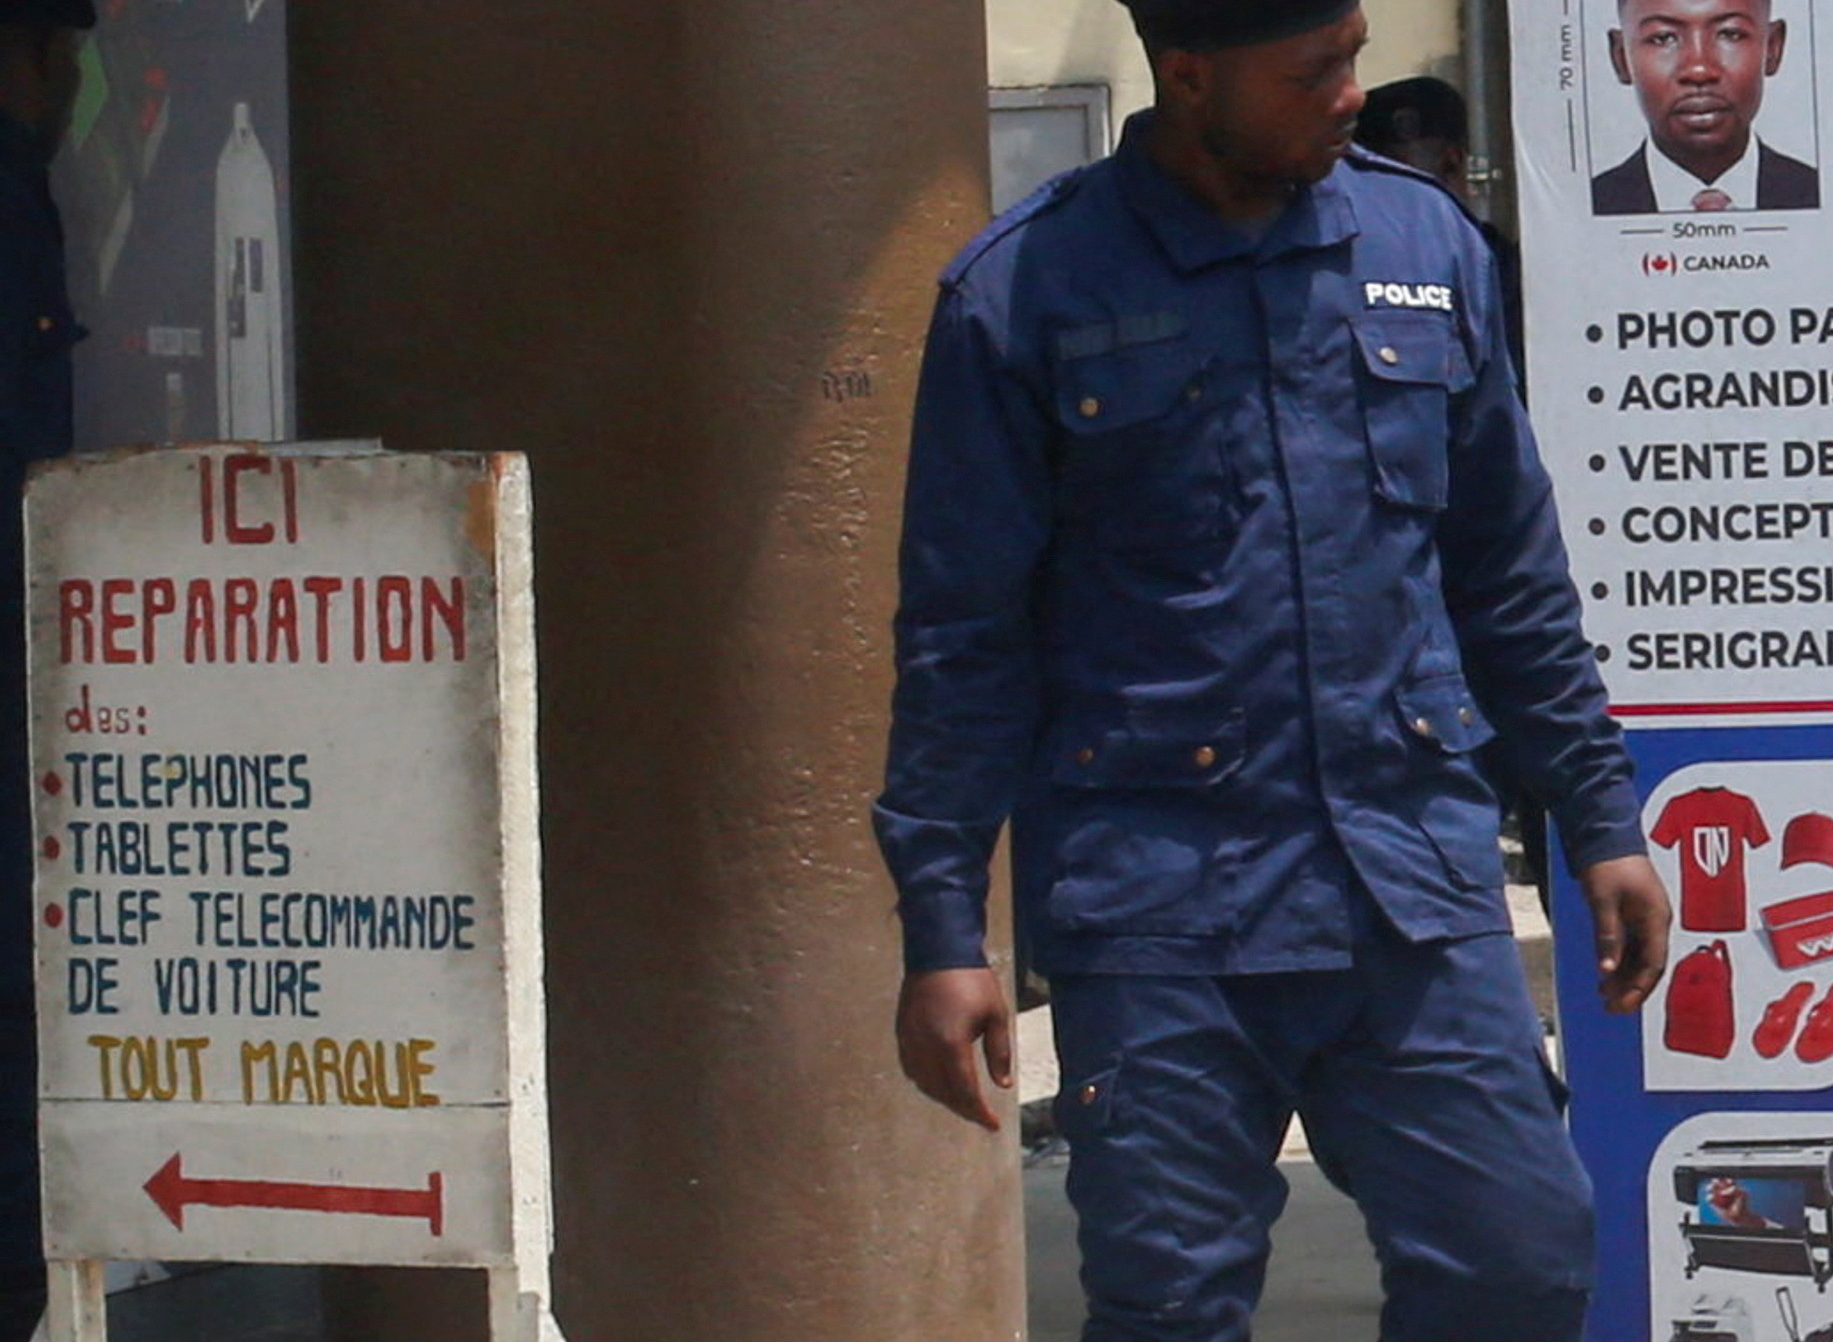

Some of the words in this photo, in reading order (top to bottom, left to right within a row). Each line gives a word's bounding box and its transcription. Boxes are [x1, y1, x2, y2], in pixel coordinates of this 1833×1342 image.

[1560, 24, 1573, 62] mm
[1559, 67, 1574, 91] 70
[1673, 220, 1737, 238] 50mm
[1683, 253, 1770, 272] CANADA
[1365, 282, 1453, 311] POLICE
[1617, 309, 1776, 350] PHOTO
[1618, 442, 1769, 482] VENTE
[199, 455, 299, 545] ICI
[58, 575, 467, 665] REPARATION
[65, 753, 311, 811] TELEPHONES
[67, 820, 291, 878] TABLETTES
[67, 888, 162, 948] CLEF
[190, 891, 475, 952] TELECOMMANDE
[68, 958, 119, 1016] DE
[155, 959, 322, 1019] VOITURE
[88, 1034, 211, 1104] TOUT
[240, 1038, 441, 1108] MARQUE
